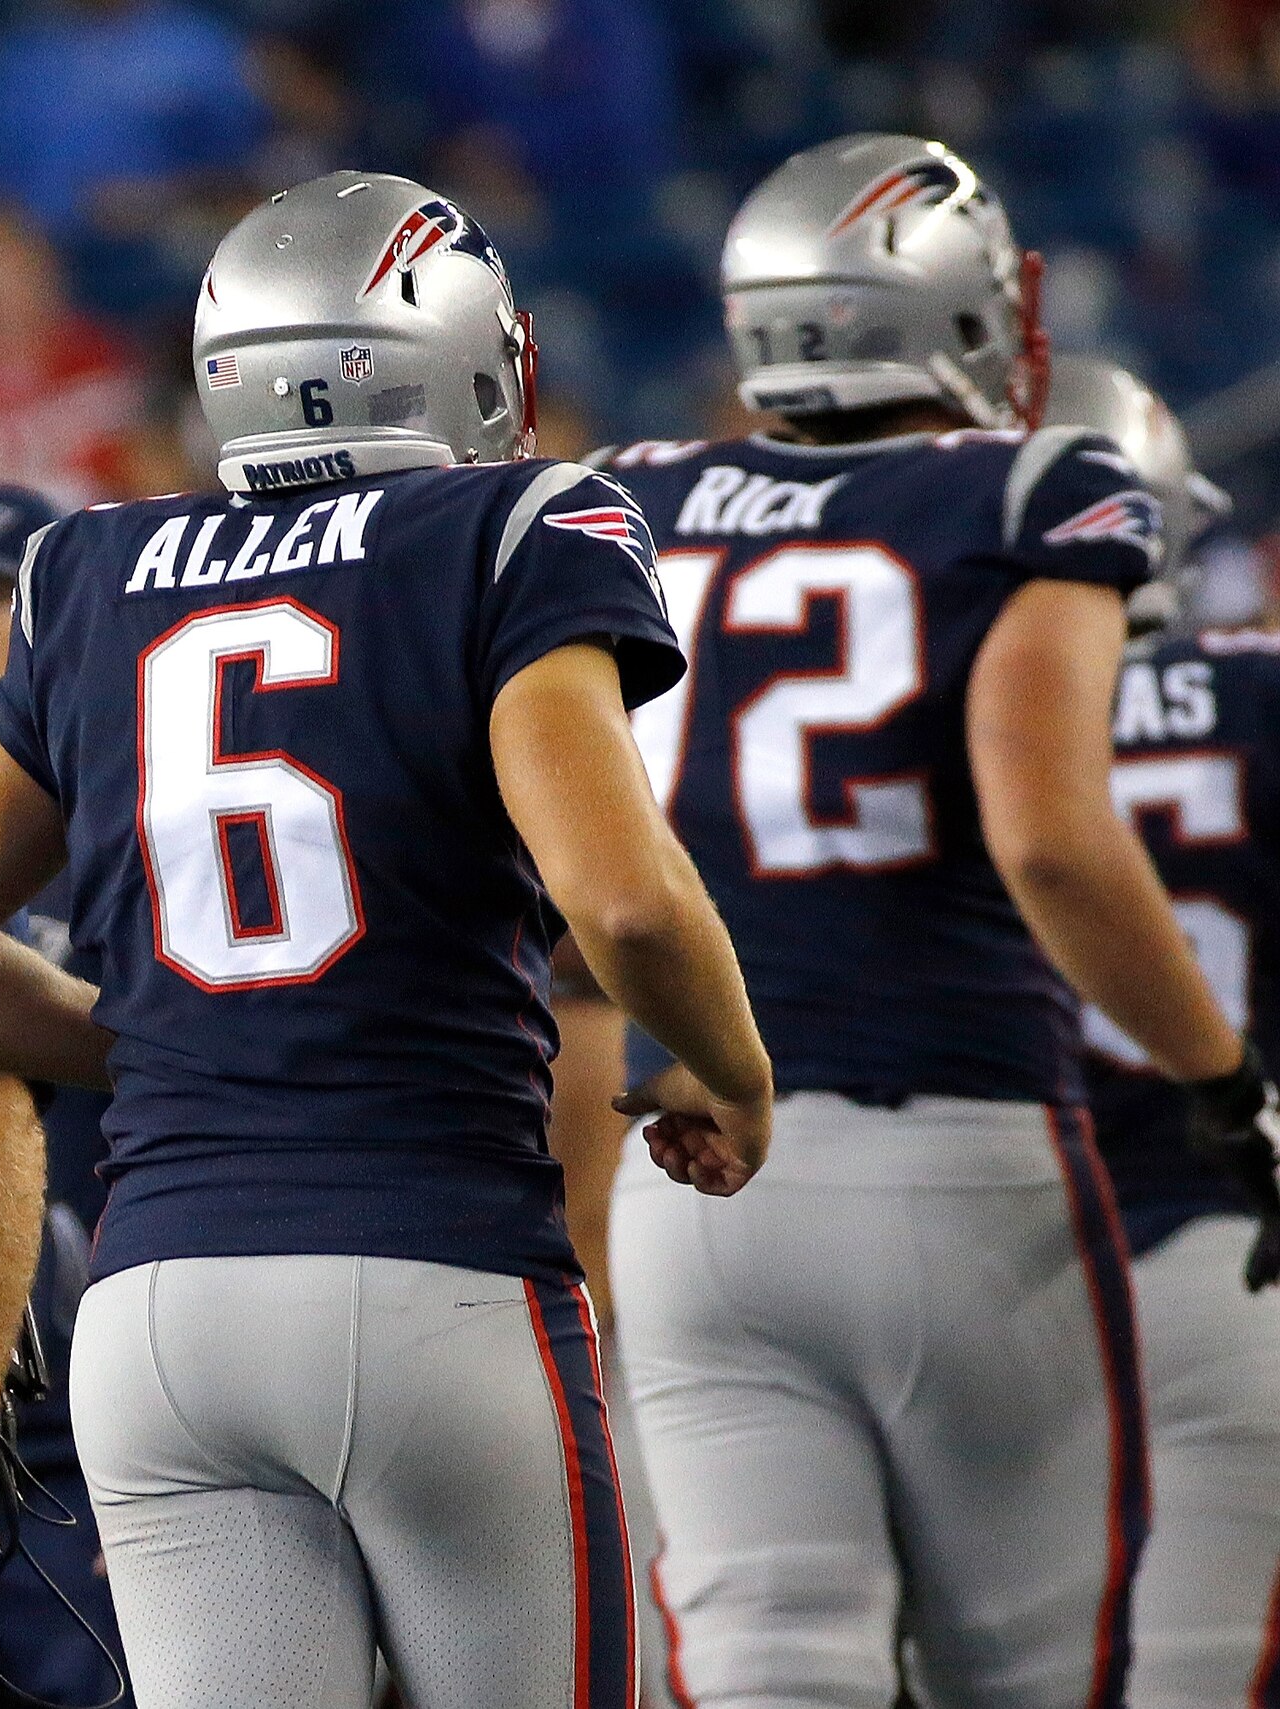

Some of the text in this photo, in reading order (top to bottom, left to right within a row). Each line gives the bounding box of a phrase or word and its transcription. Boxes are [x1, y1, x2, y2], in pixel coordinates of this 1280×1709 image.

[346, 360, 370, 378] NFL
[299, 379, 334, 427] 6
[242, 449, 356, 491] PATRIOTS
[125, 490, 384, 593] ALLEN
[136, 594, 367, 994] 6
